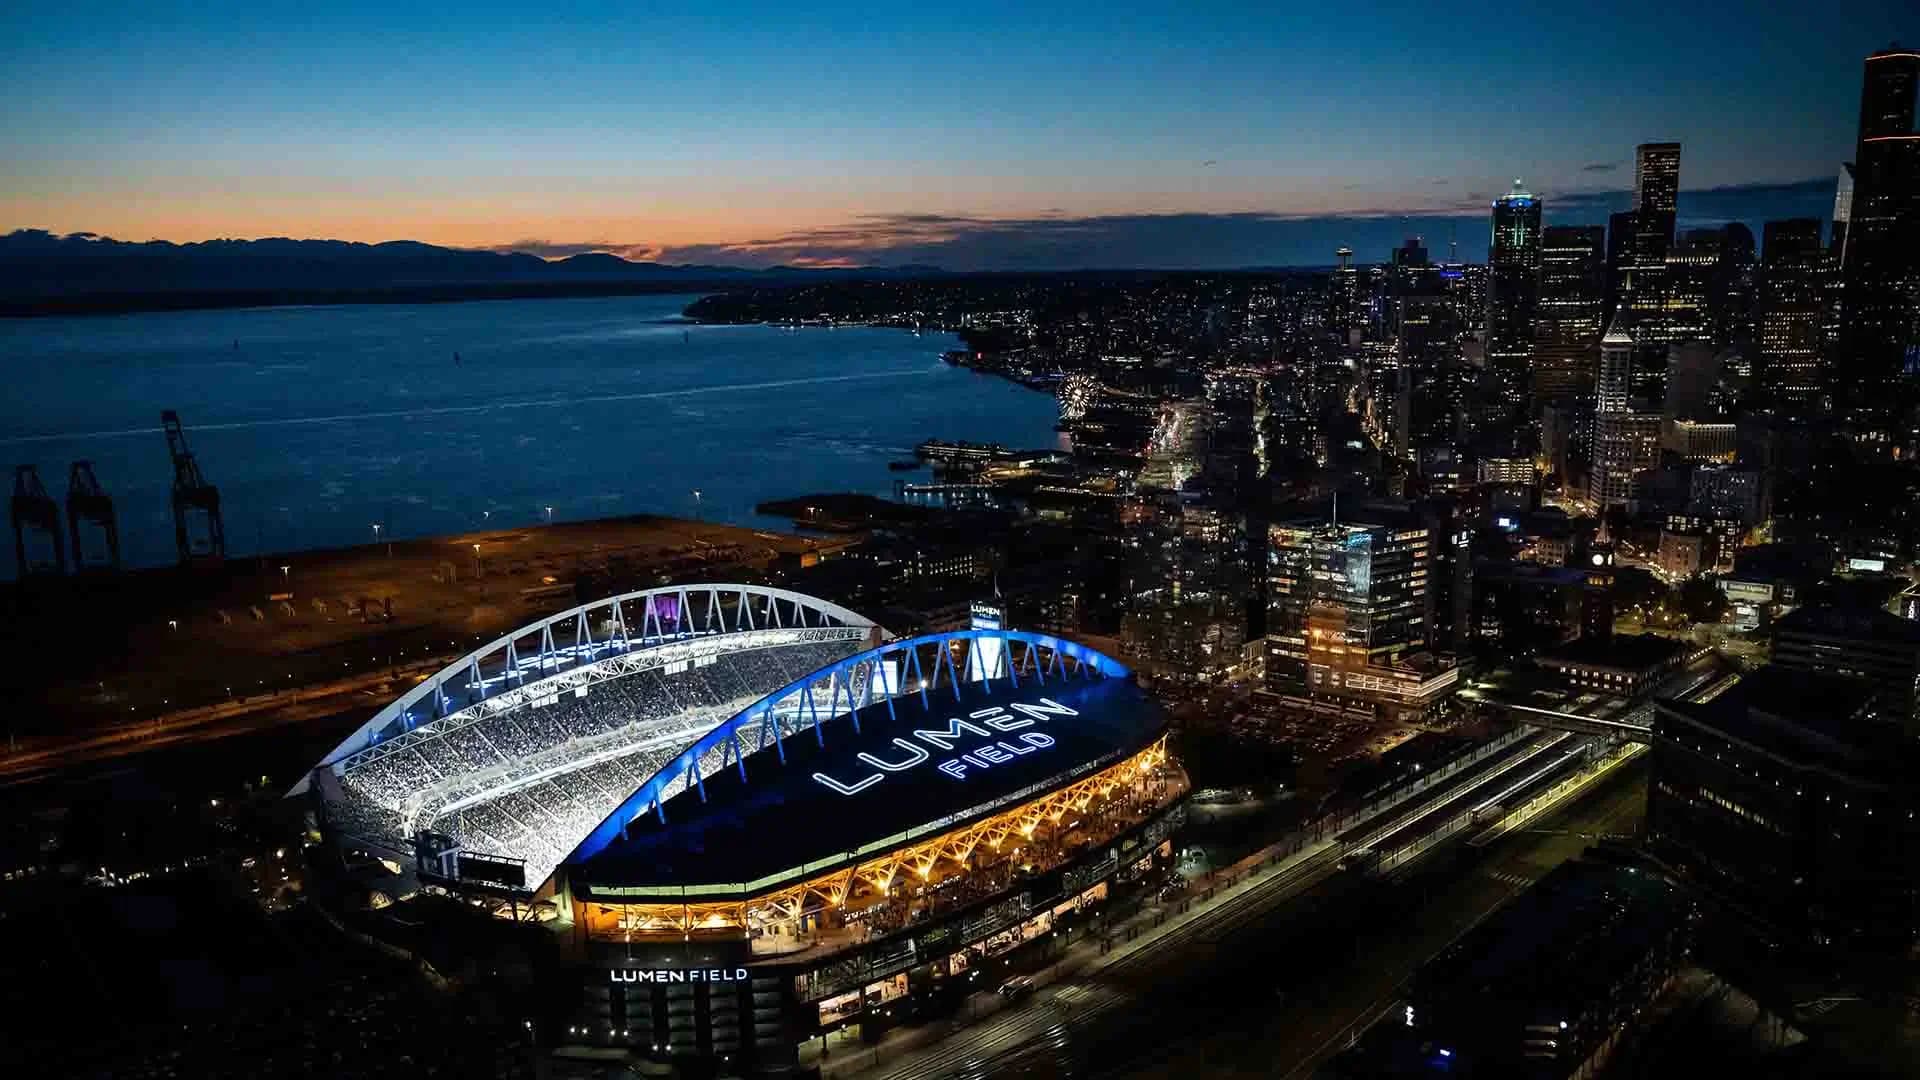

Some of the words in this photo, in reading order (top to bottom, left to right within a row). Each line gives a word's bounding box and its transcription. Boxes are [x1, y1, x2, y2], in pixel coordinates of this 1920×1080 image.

[812, 697, 1079, 796] LUMEN
[937, 732, 1055, 779] FIELD
[610, 969, 684, 983] LUMEN
[689, 968, 748, 981] FIELD
